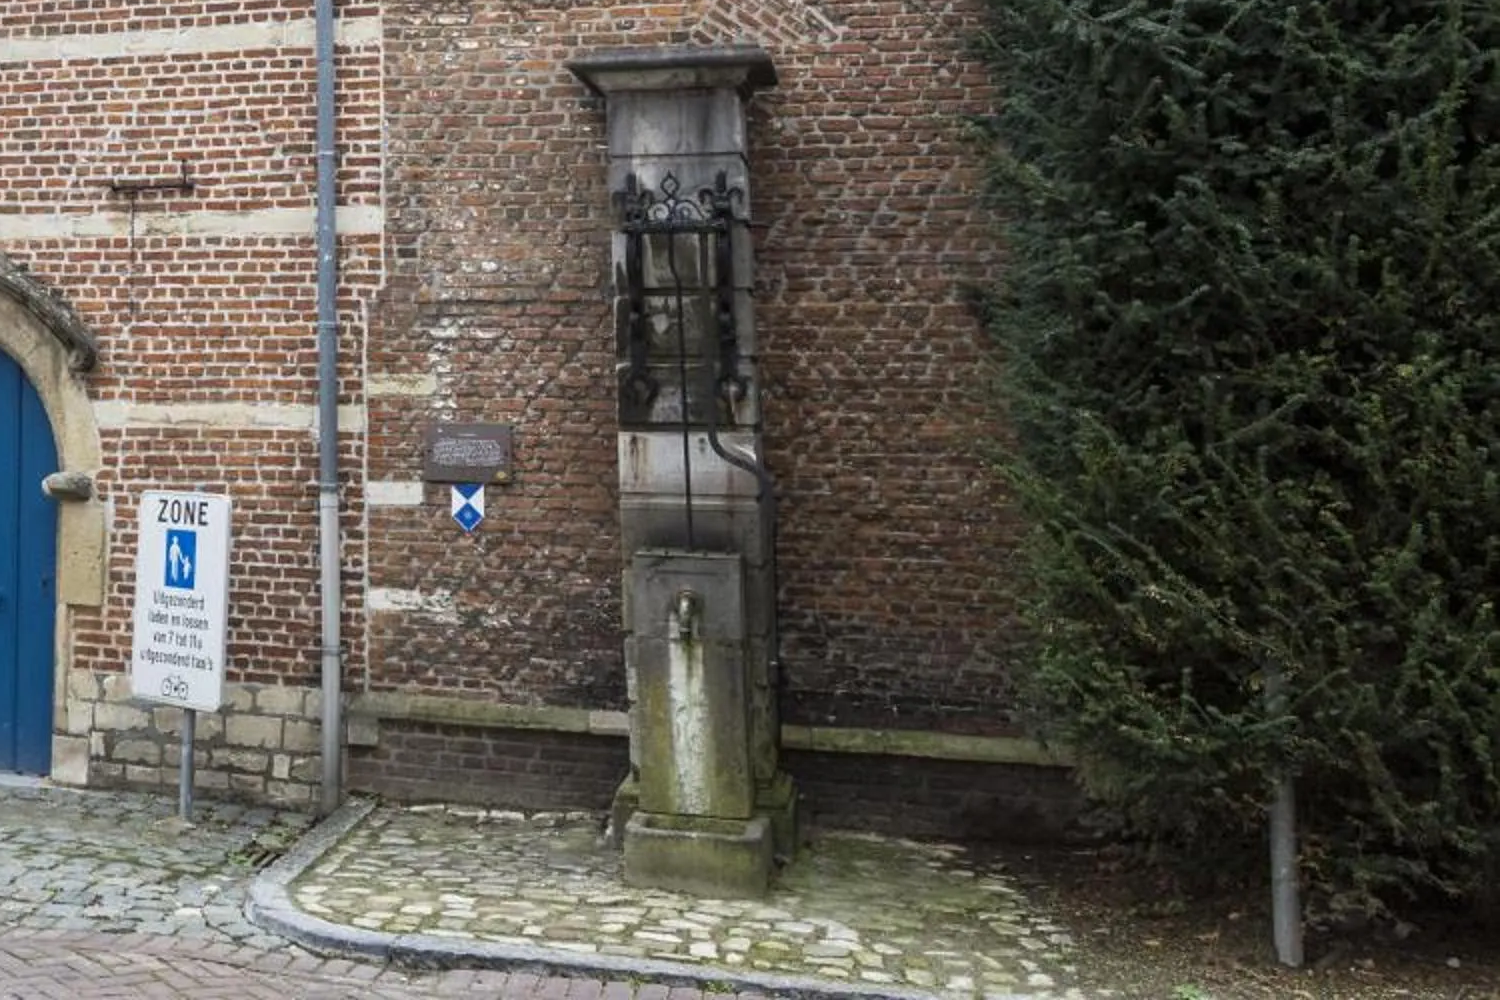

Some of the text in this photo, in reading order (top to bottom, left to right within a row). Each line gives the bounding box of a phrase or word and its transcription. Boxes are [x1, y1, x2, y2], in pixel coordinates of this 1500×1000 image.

[157, 498, 209, 526] ZONE
[148, 609, 209, 631] laden en lossen
[153, 633, 166, 645] van
[175, 633, 187, 647] tot
